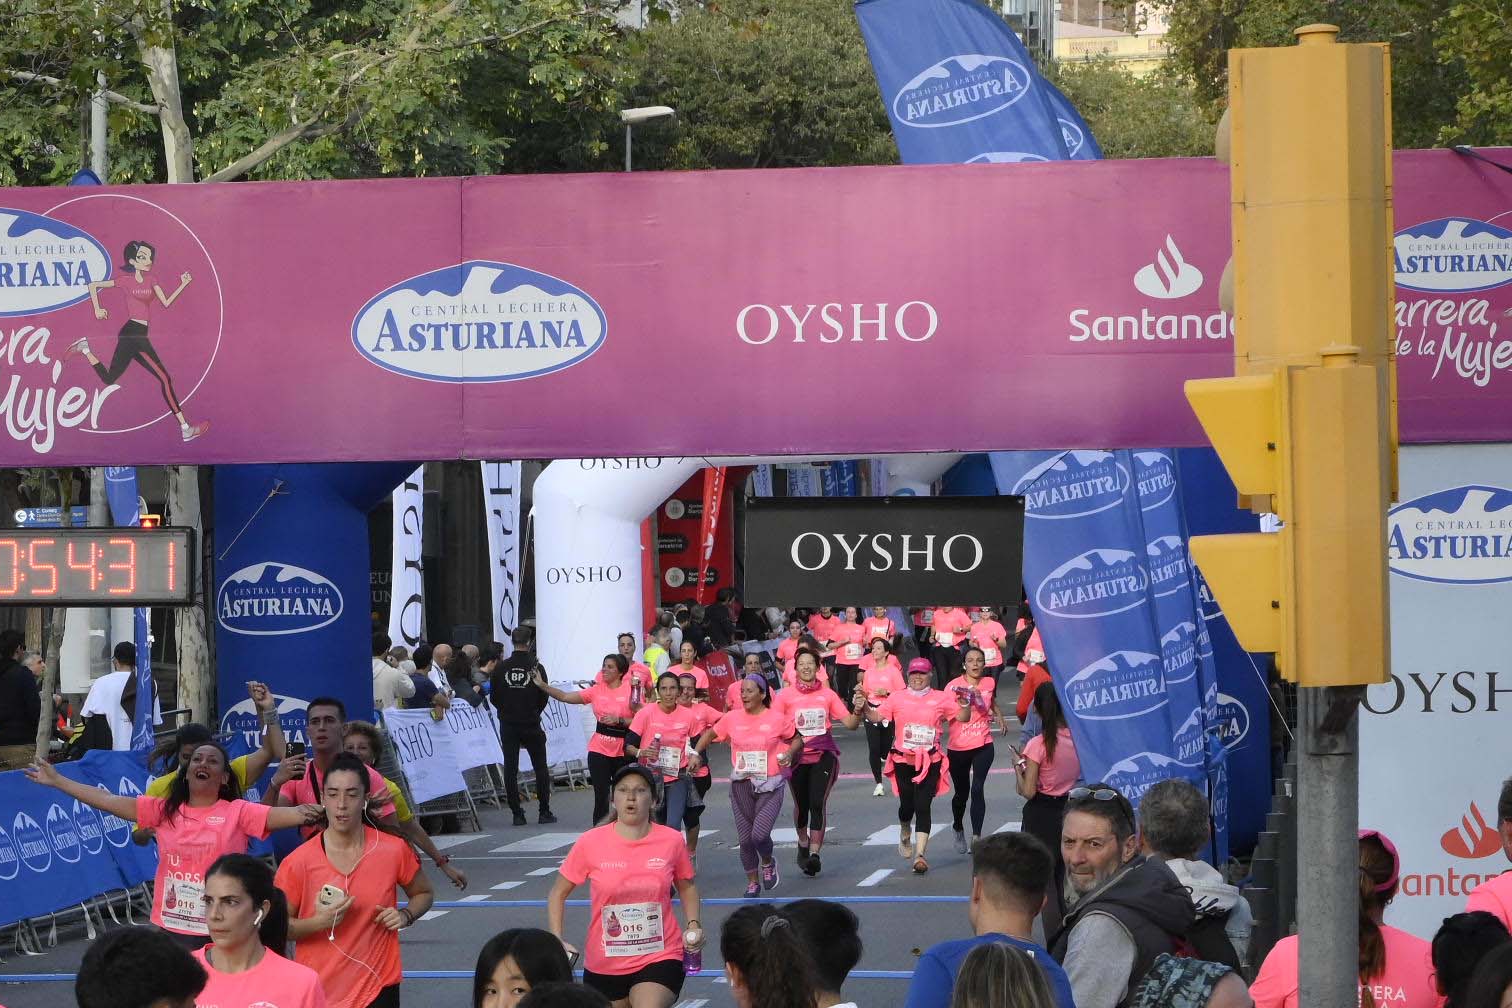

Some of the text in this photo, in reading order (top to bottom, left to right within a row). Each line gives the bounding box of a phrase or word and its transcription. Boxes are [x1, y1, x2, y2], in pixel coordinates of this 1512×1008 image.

[14, 244, 87, 256] LECHERA
[1409, 241, 1459, 252] CENTRAL
[411, 302, 578, 315] CENTRAL LECHERA
[1394, 298, 1489, 327] arrera
[373, 307, 587, 354] ASTURIANA
[736, 301, 938, 345] OYSHO
[1418, 328, 1435, 356] la
[1416, 520, 1483, 531] CENTRAL
[791, 531, 983, 573] OYSHO
[546, 564, 622, 585] OYSHO
[234, 588, 276, 596] CENTRAL
[221, 592, 334, 618] ASTURIANA
[511, 671, 525, 682] BP
[622, 924, 643, 932] 016
